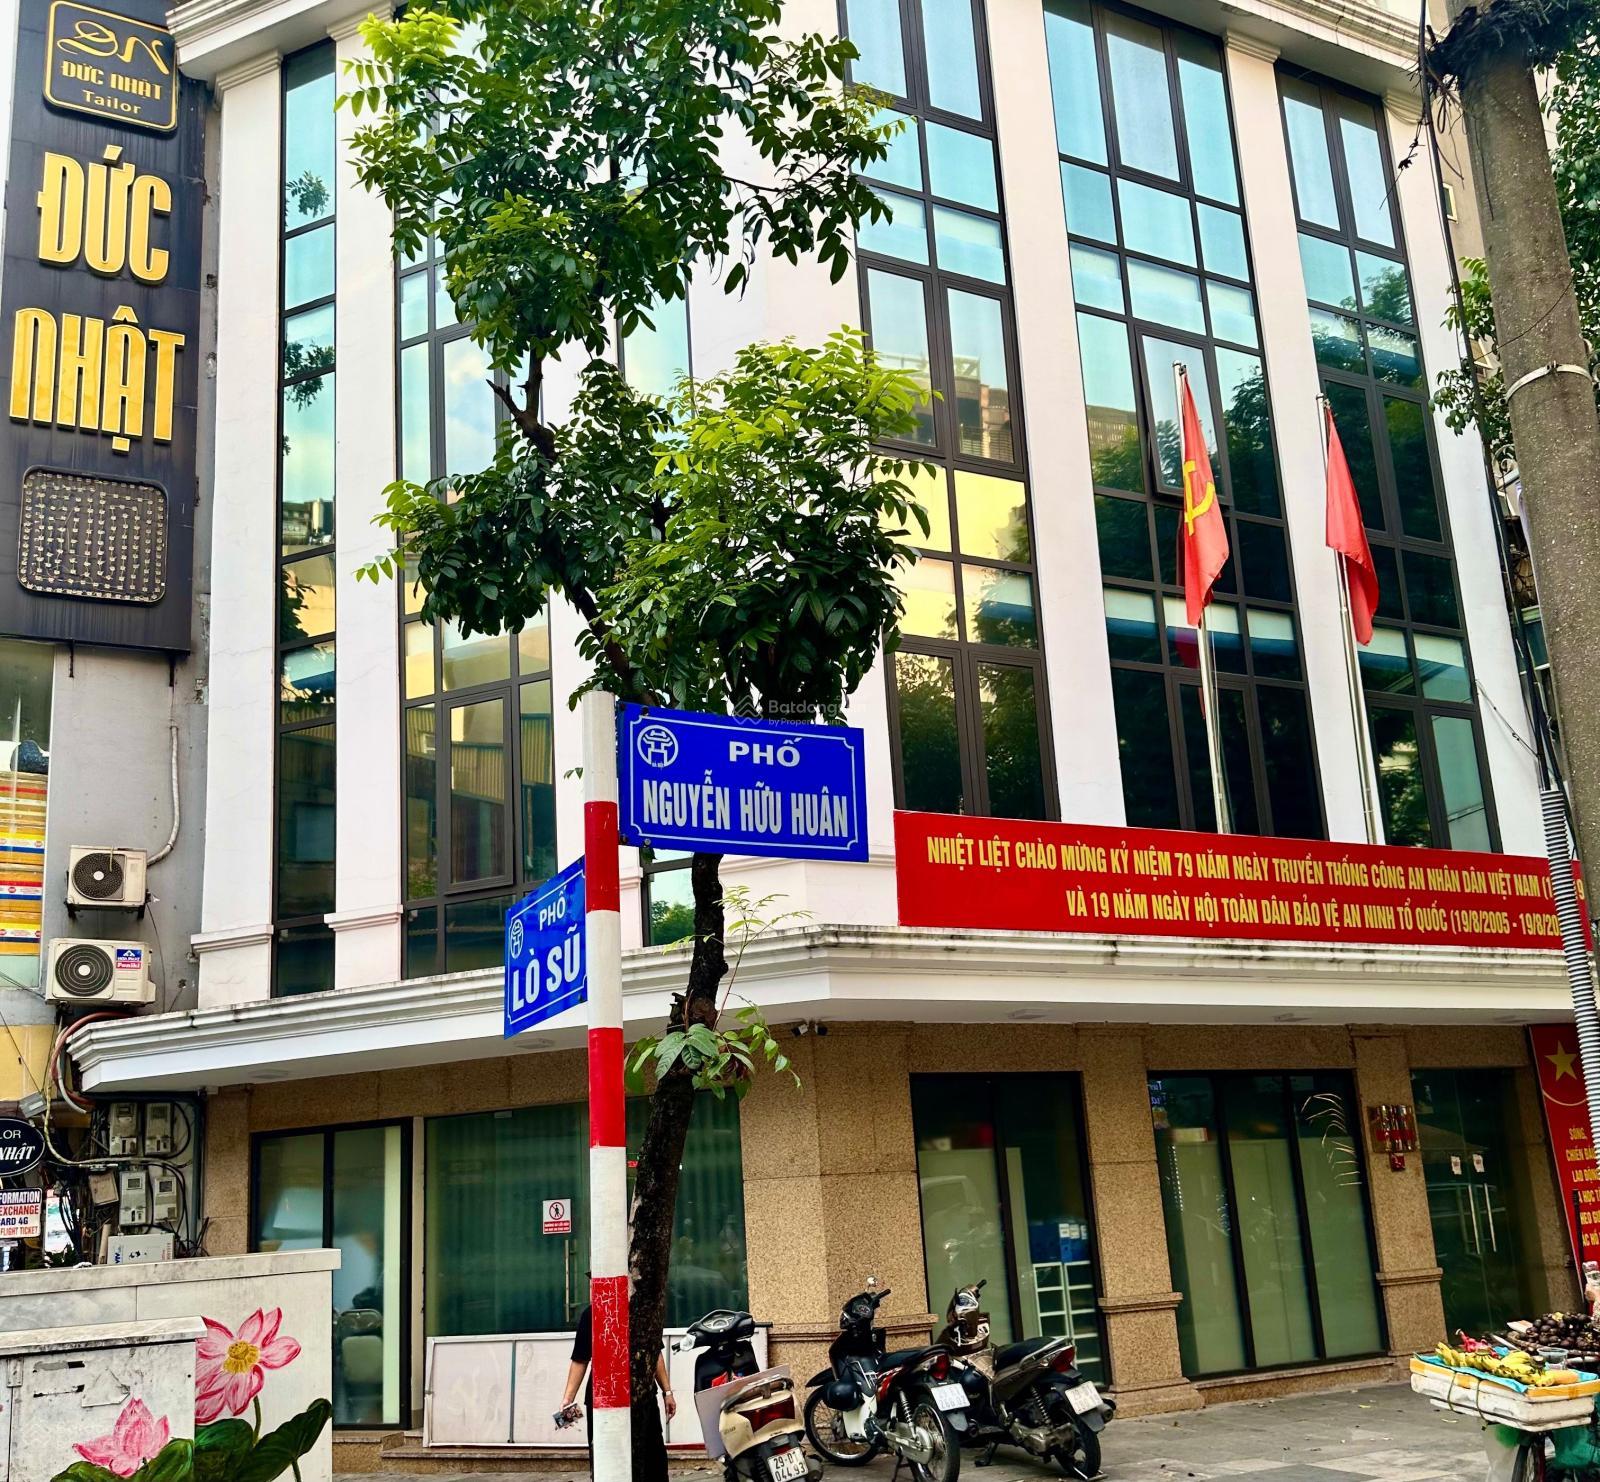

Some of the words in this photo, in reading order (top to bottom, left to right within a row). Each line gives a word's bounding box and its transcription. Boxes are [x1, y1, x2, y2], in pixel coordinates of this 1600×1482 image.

[82, 89, 142, 114] Tailor
[110, 72, 162, 100] NHẬT
[37, 144, 172, 282] ĐỨC
[9, 304, 186, 452] NHẬT
[729, 737, 803, 767] PHỐ
[642, 769, 731, 830] NGUYỄN
[740, 781, 783, 834] HỮU
[791, 786, 848, 837] HUÂN
[927, 833, 973, 871] NHIỆT
[978, 835, 1010, 873] LIỆT
[1015, 837, 1057, 870] CHÀO
[1061, 840, 1107, 873] MỪNG
[1110, 840, 1129, 874] KỶ
[1133, 845, 1172, 881] NIỆM
[1174, 852, 1193, 878] 79
[1196, 849, 1230, 880] NĂM
[1233, 851, 1269, 881] NGÀY
[1272, 852, 1324, 885] TRUYỀN
[1326, 854, 1369, 887] THỐNG
[1370, 860, 1404, 889] CÔNG
[1408, 866, 1425, 890] AN
[1427, 864, 1461, 893] NHÂN
[1462, 866, 1487, 894] DÂN
[1487, 868, 1512, 900] VIỆT
[1514, 874, 1540, 898] NAM
[539, 885, 567, 931] PHỐ
[1066, 885, 1087, 917] VÀ
[1091, 891, 1109, 918] 19
[1113, 888, 1149, 919] NĂM
[1151, 890, 1190, 921] NGÀY
[1194, 892, 1219, 927] HỘI
[1221, 893, 1259, 924] TOÀN
[1261, 895, 1291, 925] DÂN
[1293, 894, 1320, 927] BẢO
[1322, 898, 1340, 932] VỆ
[1343, 904, 1361, 928] AN
[1364, 904, 1396, 930] NINH
[1397, 898, 1413, 930] TỔ
[1416, 900, 1448, 933] QUỐC
[1450, 909, 1511, 934] (19/8/2005
[1519, 913, 1562, 936] 19/8/20
[512, 948, 540, 1012] LÒ
[546, 923, 581, 993] SŨ
[18, 1217, 28, 1226] 4G
[20, 1226, 38, 1235] TICKET
